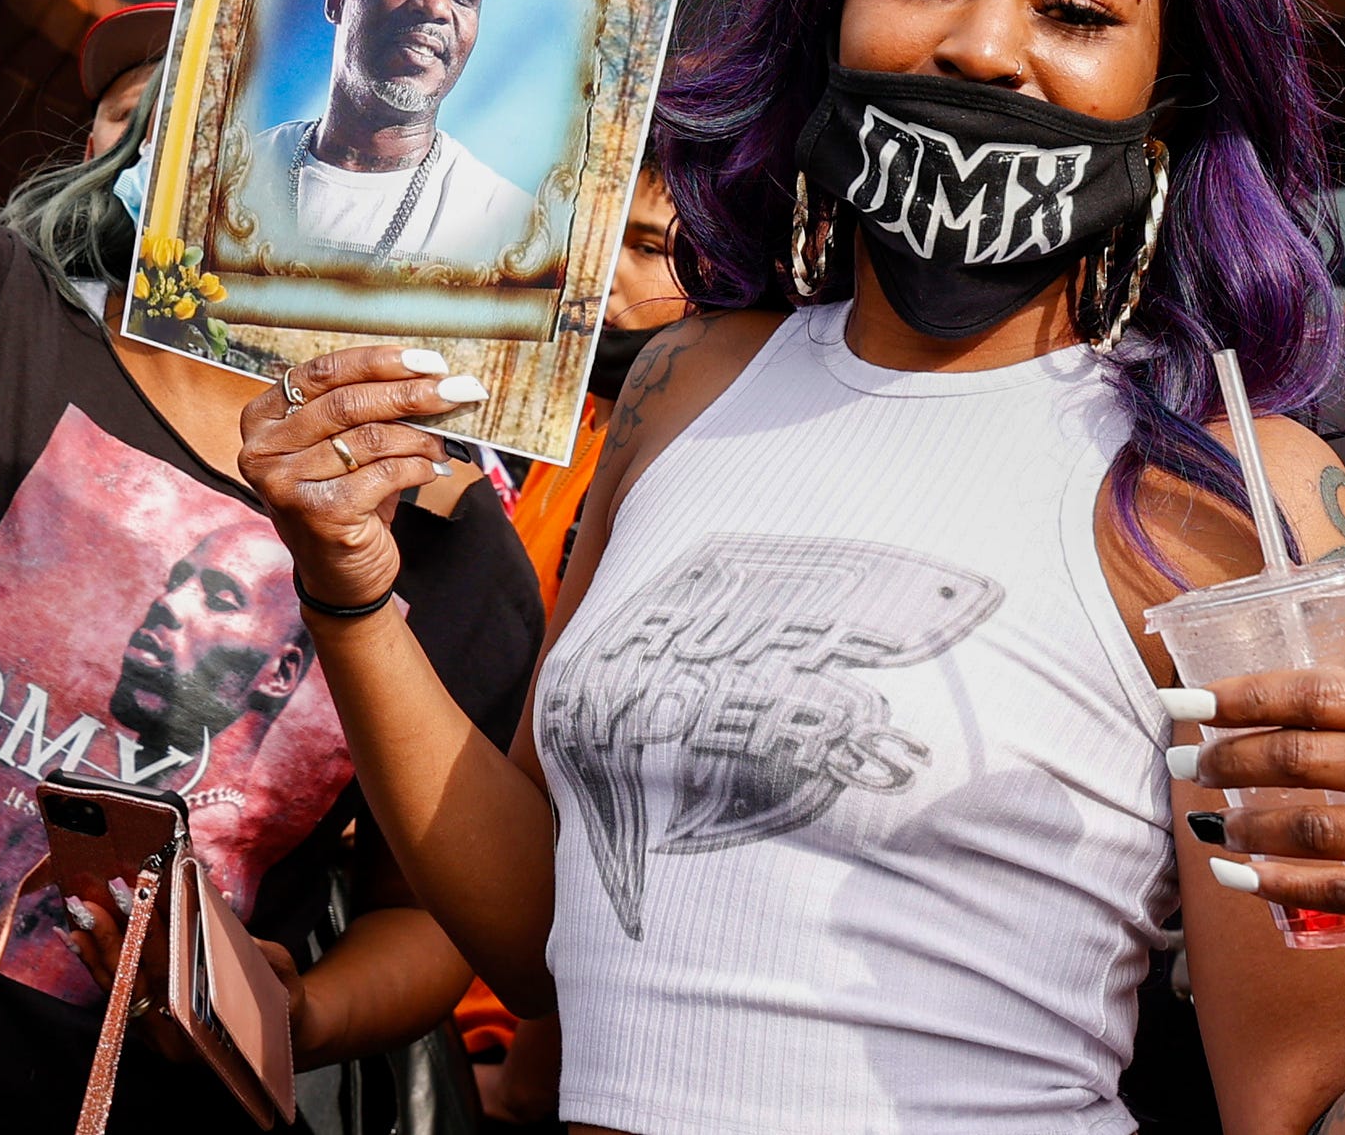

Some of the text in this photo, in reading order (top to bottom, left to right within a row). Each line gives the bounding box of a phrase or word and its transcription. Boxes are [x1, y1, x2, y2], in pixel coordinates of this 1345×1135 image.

[847, 104, 1092, 265] DMX
[600, 604, 906, 674] RUFF
[541, 683, 933, 796] RYDERS
